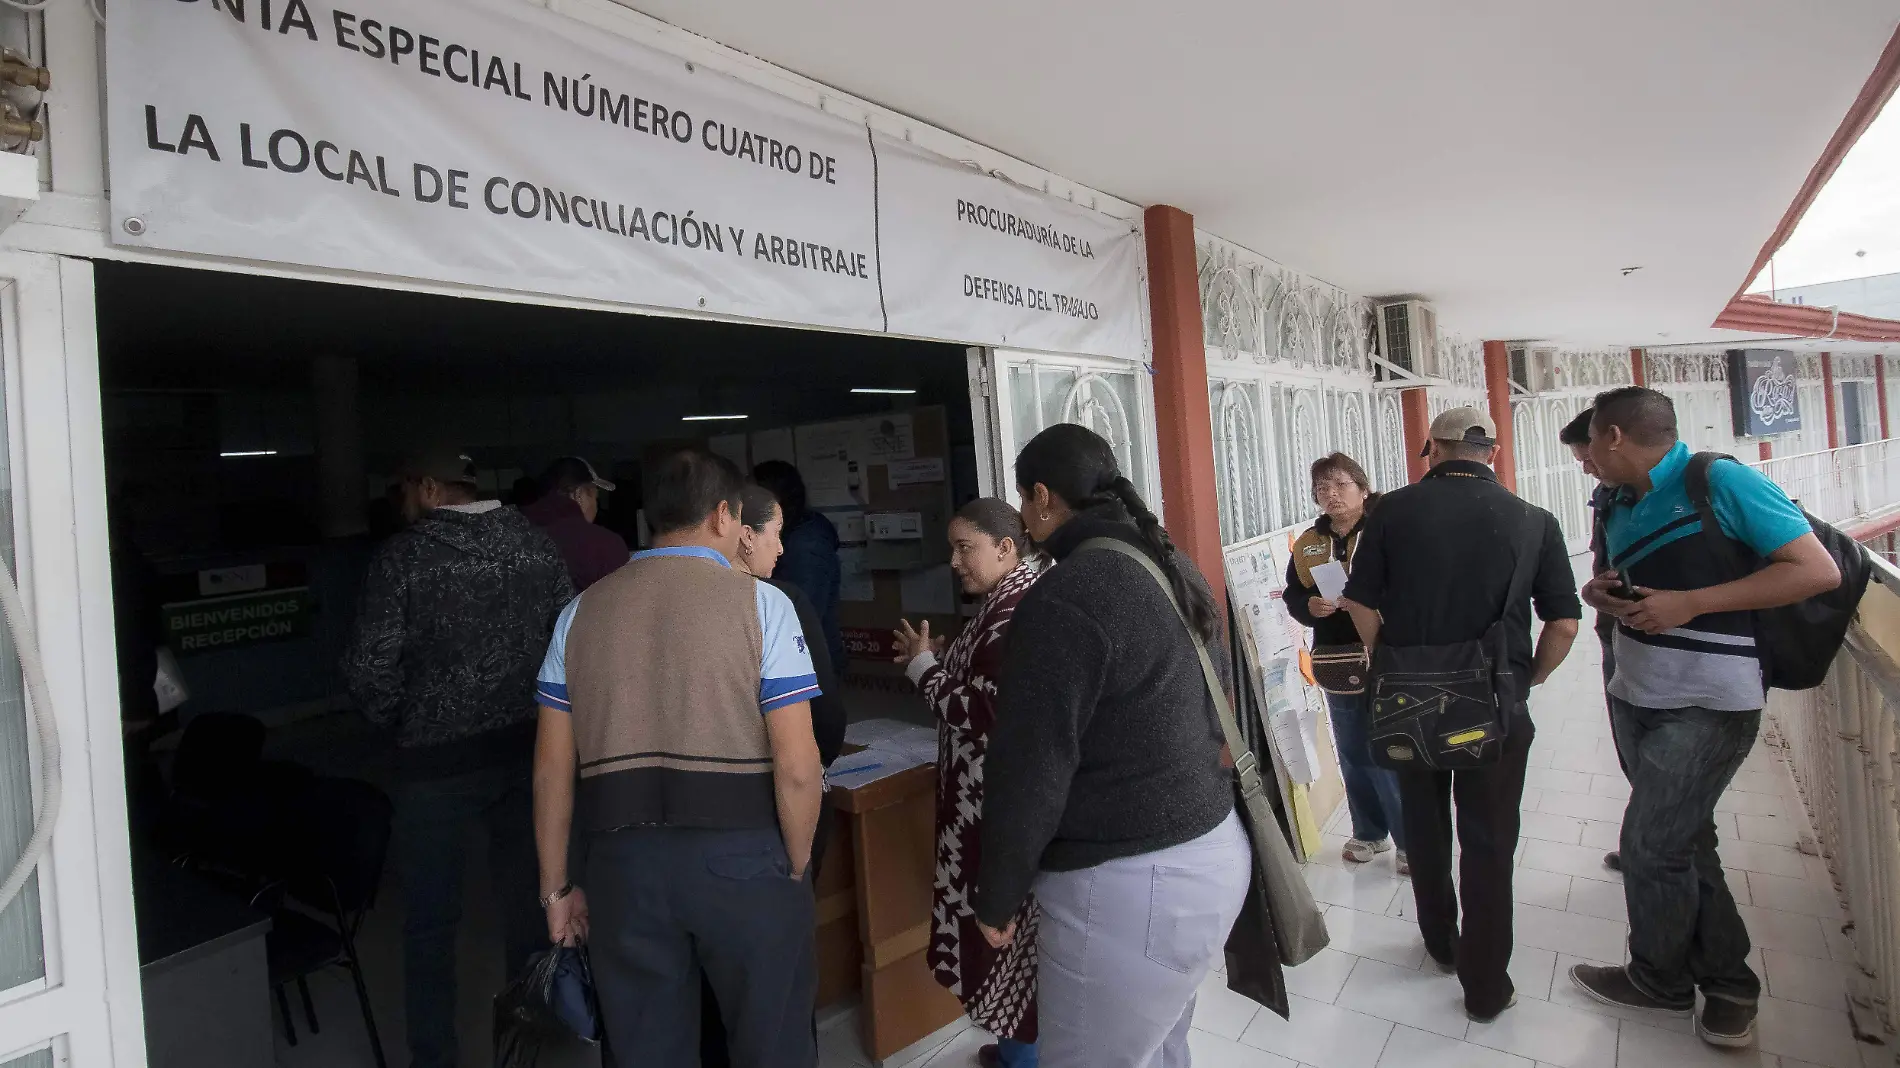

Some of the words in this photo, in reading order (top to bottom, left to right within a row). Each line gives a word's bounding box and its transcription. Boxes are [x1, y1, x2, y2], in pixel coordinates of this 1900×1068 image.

[333, 10, 531, 101] ESPECIAL
[544, 71, 692, 143] NÚMERO
[702, 120, 802, 173] CUATRO
[810, 151, 836, 185] DE
[145, 105, 220, 162] LA
[240, 123, 399, 197] LOCAL
[414, 163, 469, 209] DE
[484, 177, 724, 253] CONCILIACIÓN
[729, 227, 744, 256] Y
[754, 232, 868, 279] ARBITRAJE
[957, 199, 1061, 253] PROCURADURÍA
[1062, 232, 1079, 255] DE
[1080, 239, 1094, 259] LA
[964, 274, 1024, 307] DEFENSA
[1028, 288, 1052, 311] DEL
[1053, 294, 1098, 320] TRABAJO
[170, 600, 299, 631] BIENVENIDOS
[181, 620, 292, 649] RECEPCIÓN
